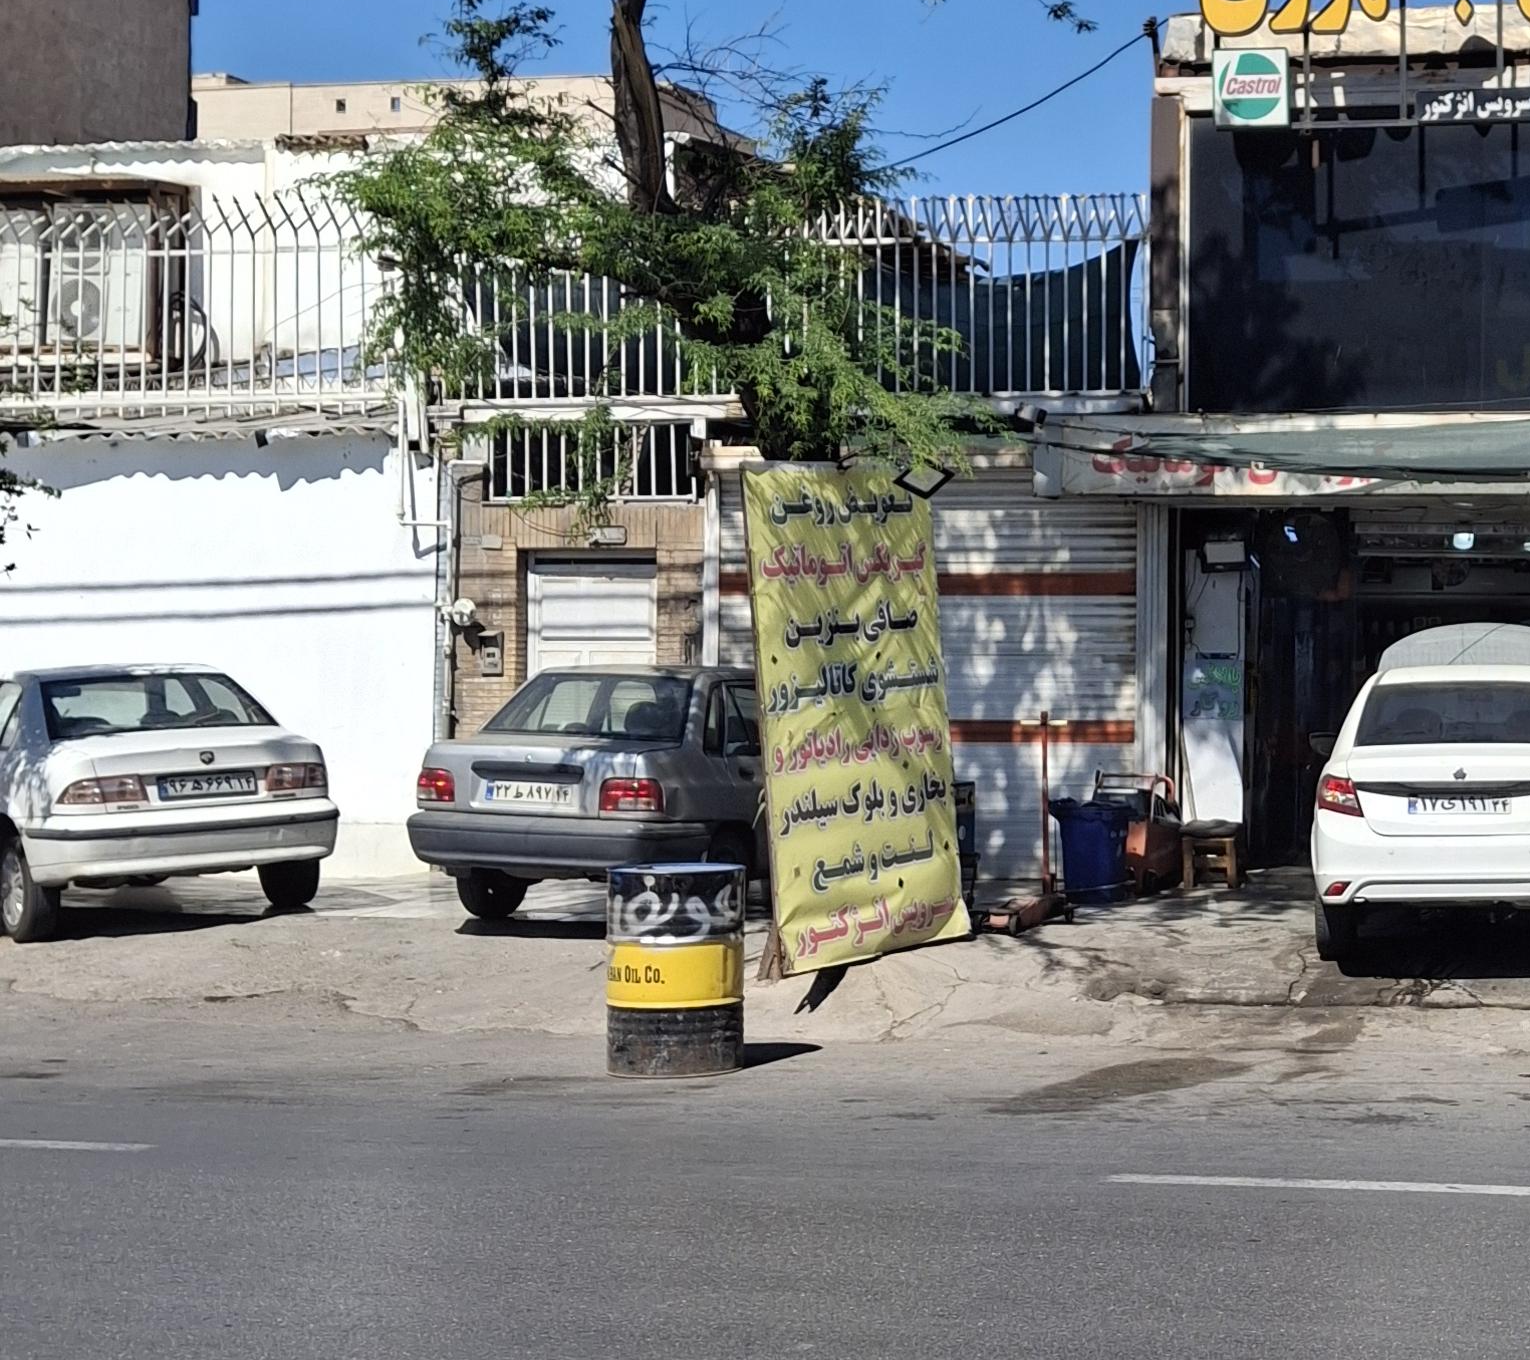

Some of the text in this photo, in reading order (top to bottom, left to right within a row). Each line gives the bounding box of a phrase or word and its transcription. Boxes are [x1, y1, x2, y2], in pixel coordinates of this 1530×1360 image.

[1226, 77, 1281, 95] Castrol
[1421, 90, 1475, 121] انژکتور
[769, 486, 836, 526] روغن
[761, 541, 927, 587] گیربکس اتوماتیک
[785, 598, 919, 649] صافی بنزین
[766, 654, 940, 714] شستشوی کاتالیزور
[773, 746, 784, 774] و
[788, 723, 852, 772] رادیاتور
[902, 722, 945, 752] رسوب
[778, 767, 948, 837] بخاری و بلوک سیلندر
[813, 828, 934, 892] لنت و شمع
[796, 896, 890, 958] انژکتور
